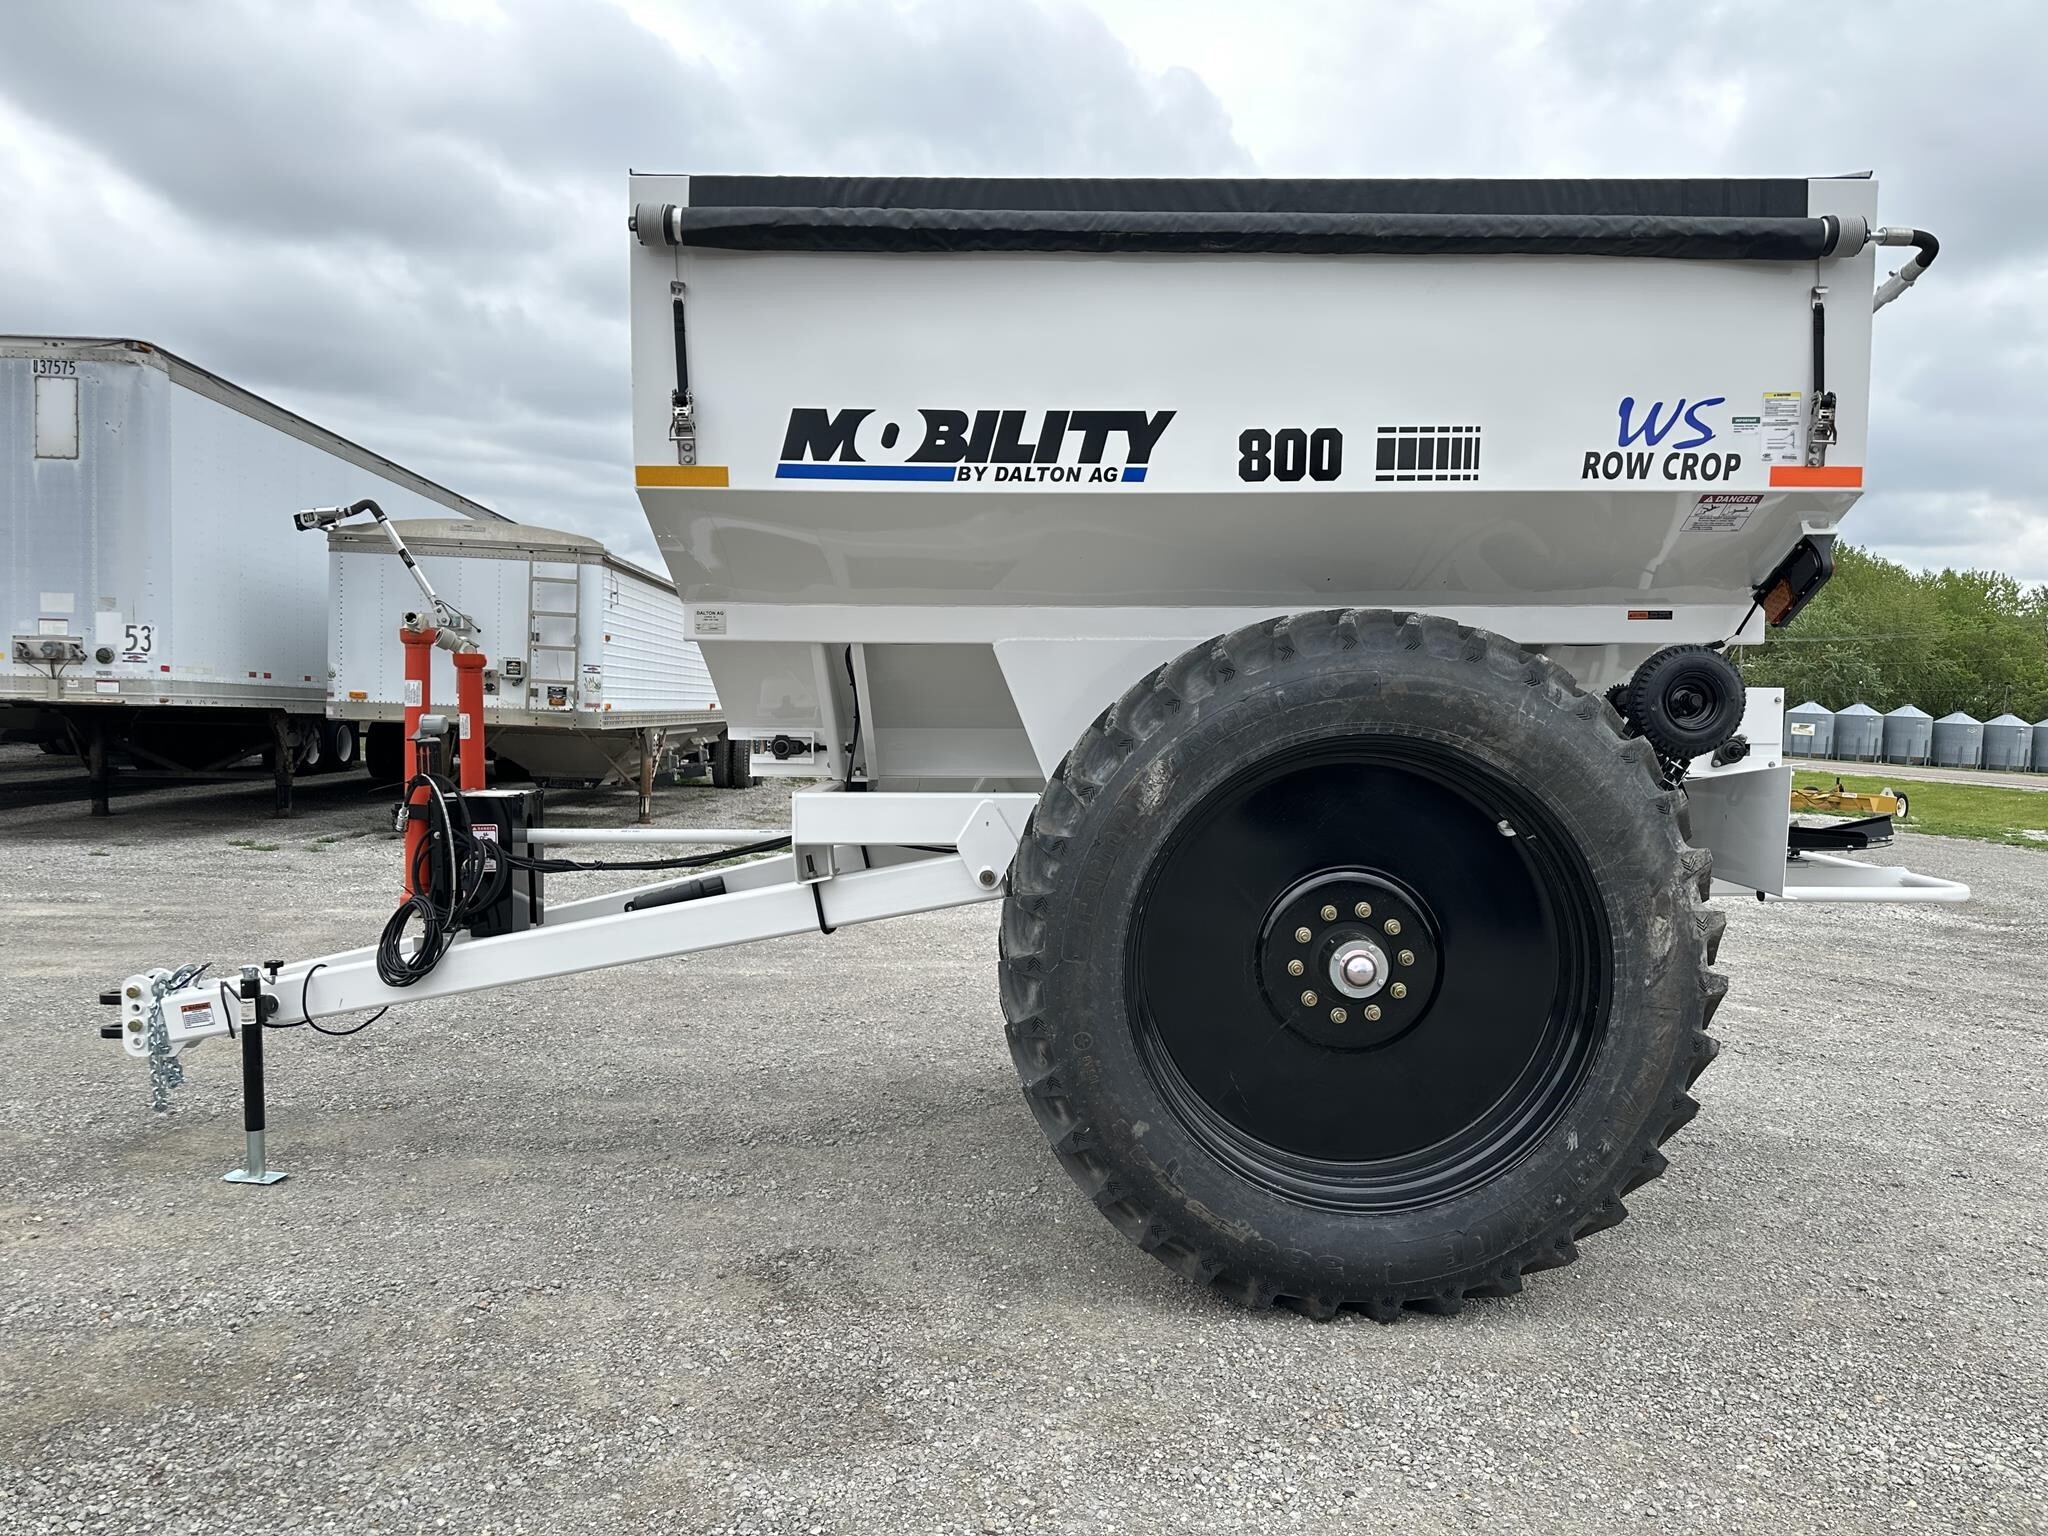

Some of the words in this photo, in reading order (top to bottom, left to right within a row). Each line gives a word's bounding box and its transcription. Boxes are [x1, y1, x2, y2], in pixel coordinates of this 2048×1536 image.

[780, 408, 1178, 463] MOBILITY
[1618, 397, 1726, 450] WS
[956, 466, 985, 481] BY
[994, 466, 1084, 482] DALTON
[1088, 467, 1118, 482] AG
[1238, 428, 1343, 482] 800
[1581, 451, 1655, 480] ROW
[1662, 452, 1742, 481] CROP
[1715, 495, 1758, 503] DANGER
